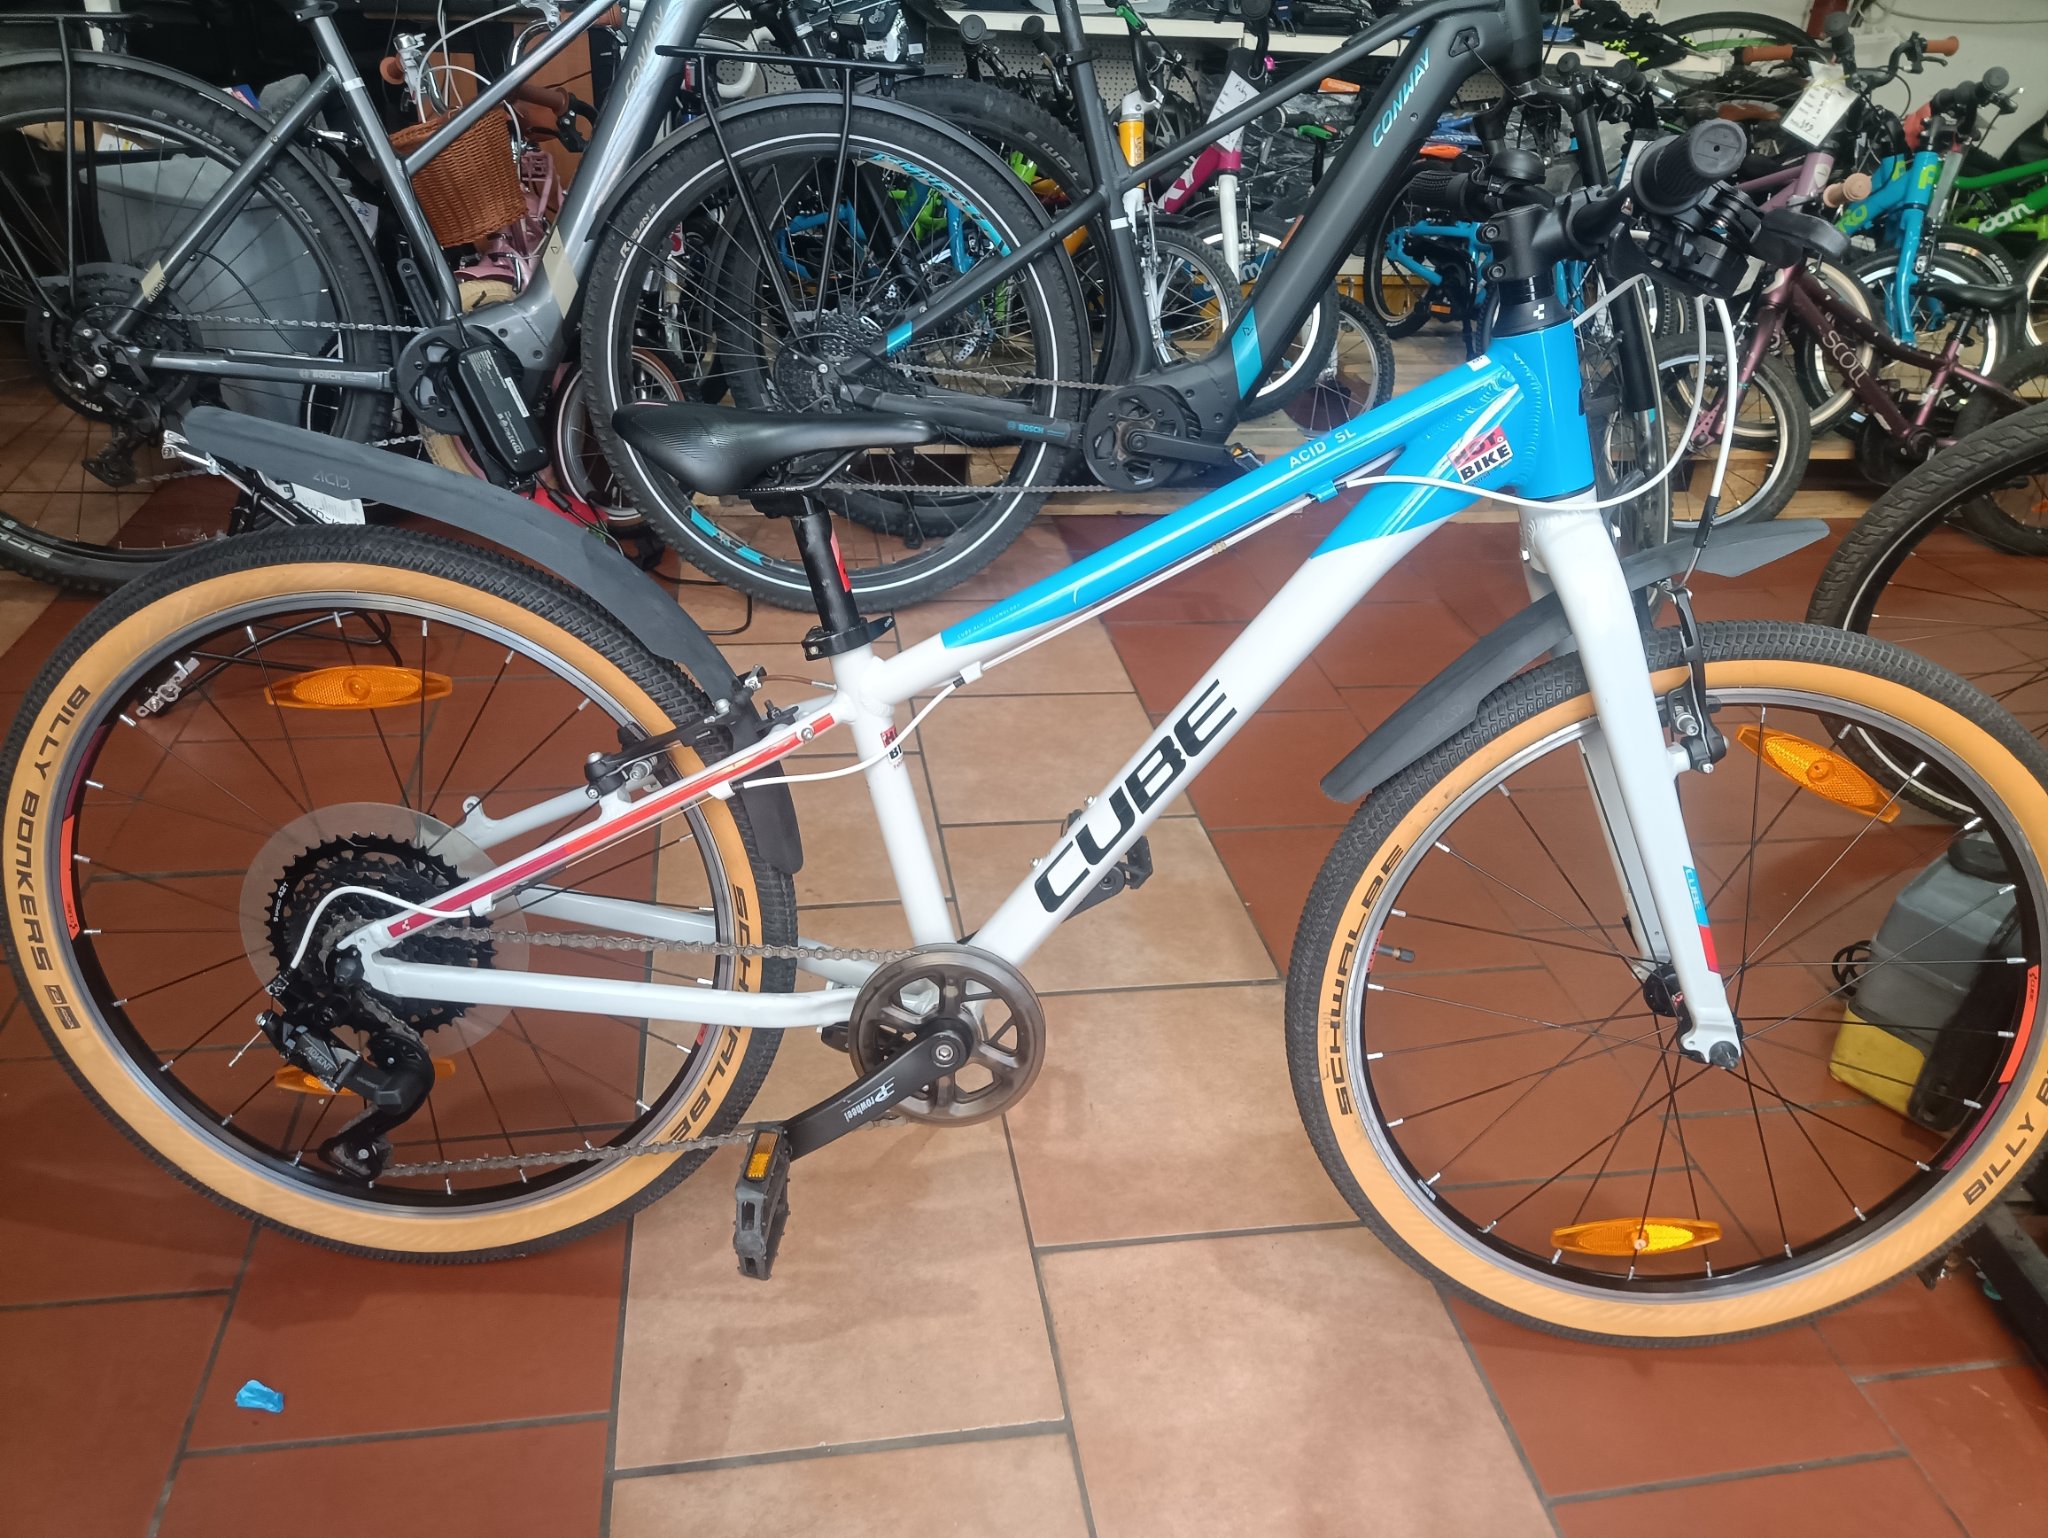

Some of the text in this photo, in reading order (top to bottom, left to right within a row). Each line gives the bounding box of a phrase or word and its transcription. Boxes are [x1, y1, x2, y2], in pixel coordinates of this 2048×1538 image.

[1373, 47, 1429, 147] CONWAY
[1040, 142, 1079, 181] TOM
[312, 372, 342, 381] BOSCH
[1822, 330, 1869, 388] SCOTT
[1018, 423, 1045, 434] BOSCH
[1289, 428, 1357, 469] ACID SL
[1460, 444, 1510, 481] BIKE
[1034, 679, 1237, 913] CUBE
[15, 684, 91, 971] BILLY BONKERS
[277, 881, 289, 898] 42T
[1684, 868, 1702, 912] CUBE
[1330, 844, 1403, 1116] SCHWALBE
[670, 883, 751, 1142] SCHALBE
[304, 1046, 334, 1071] ADVENT
[843, 1076, 896, 1123] Prowheel
[1963, 1111, 2035, 1206] BILLY
